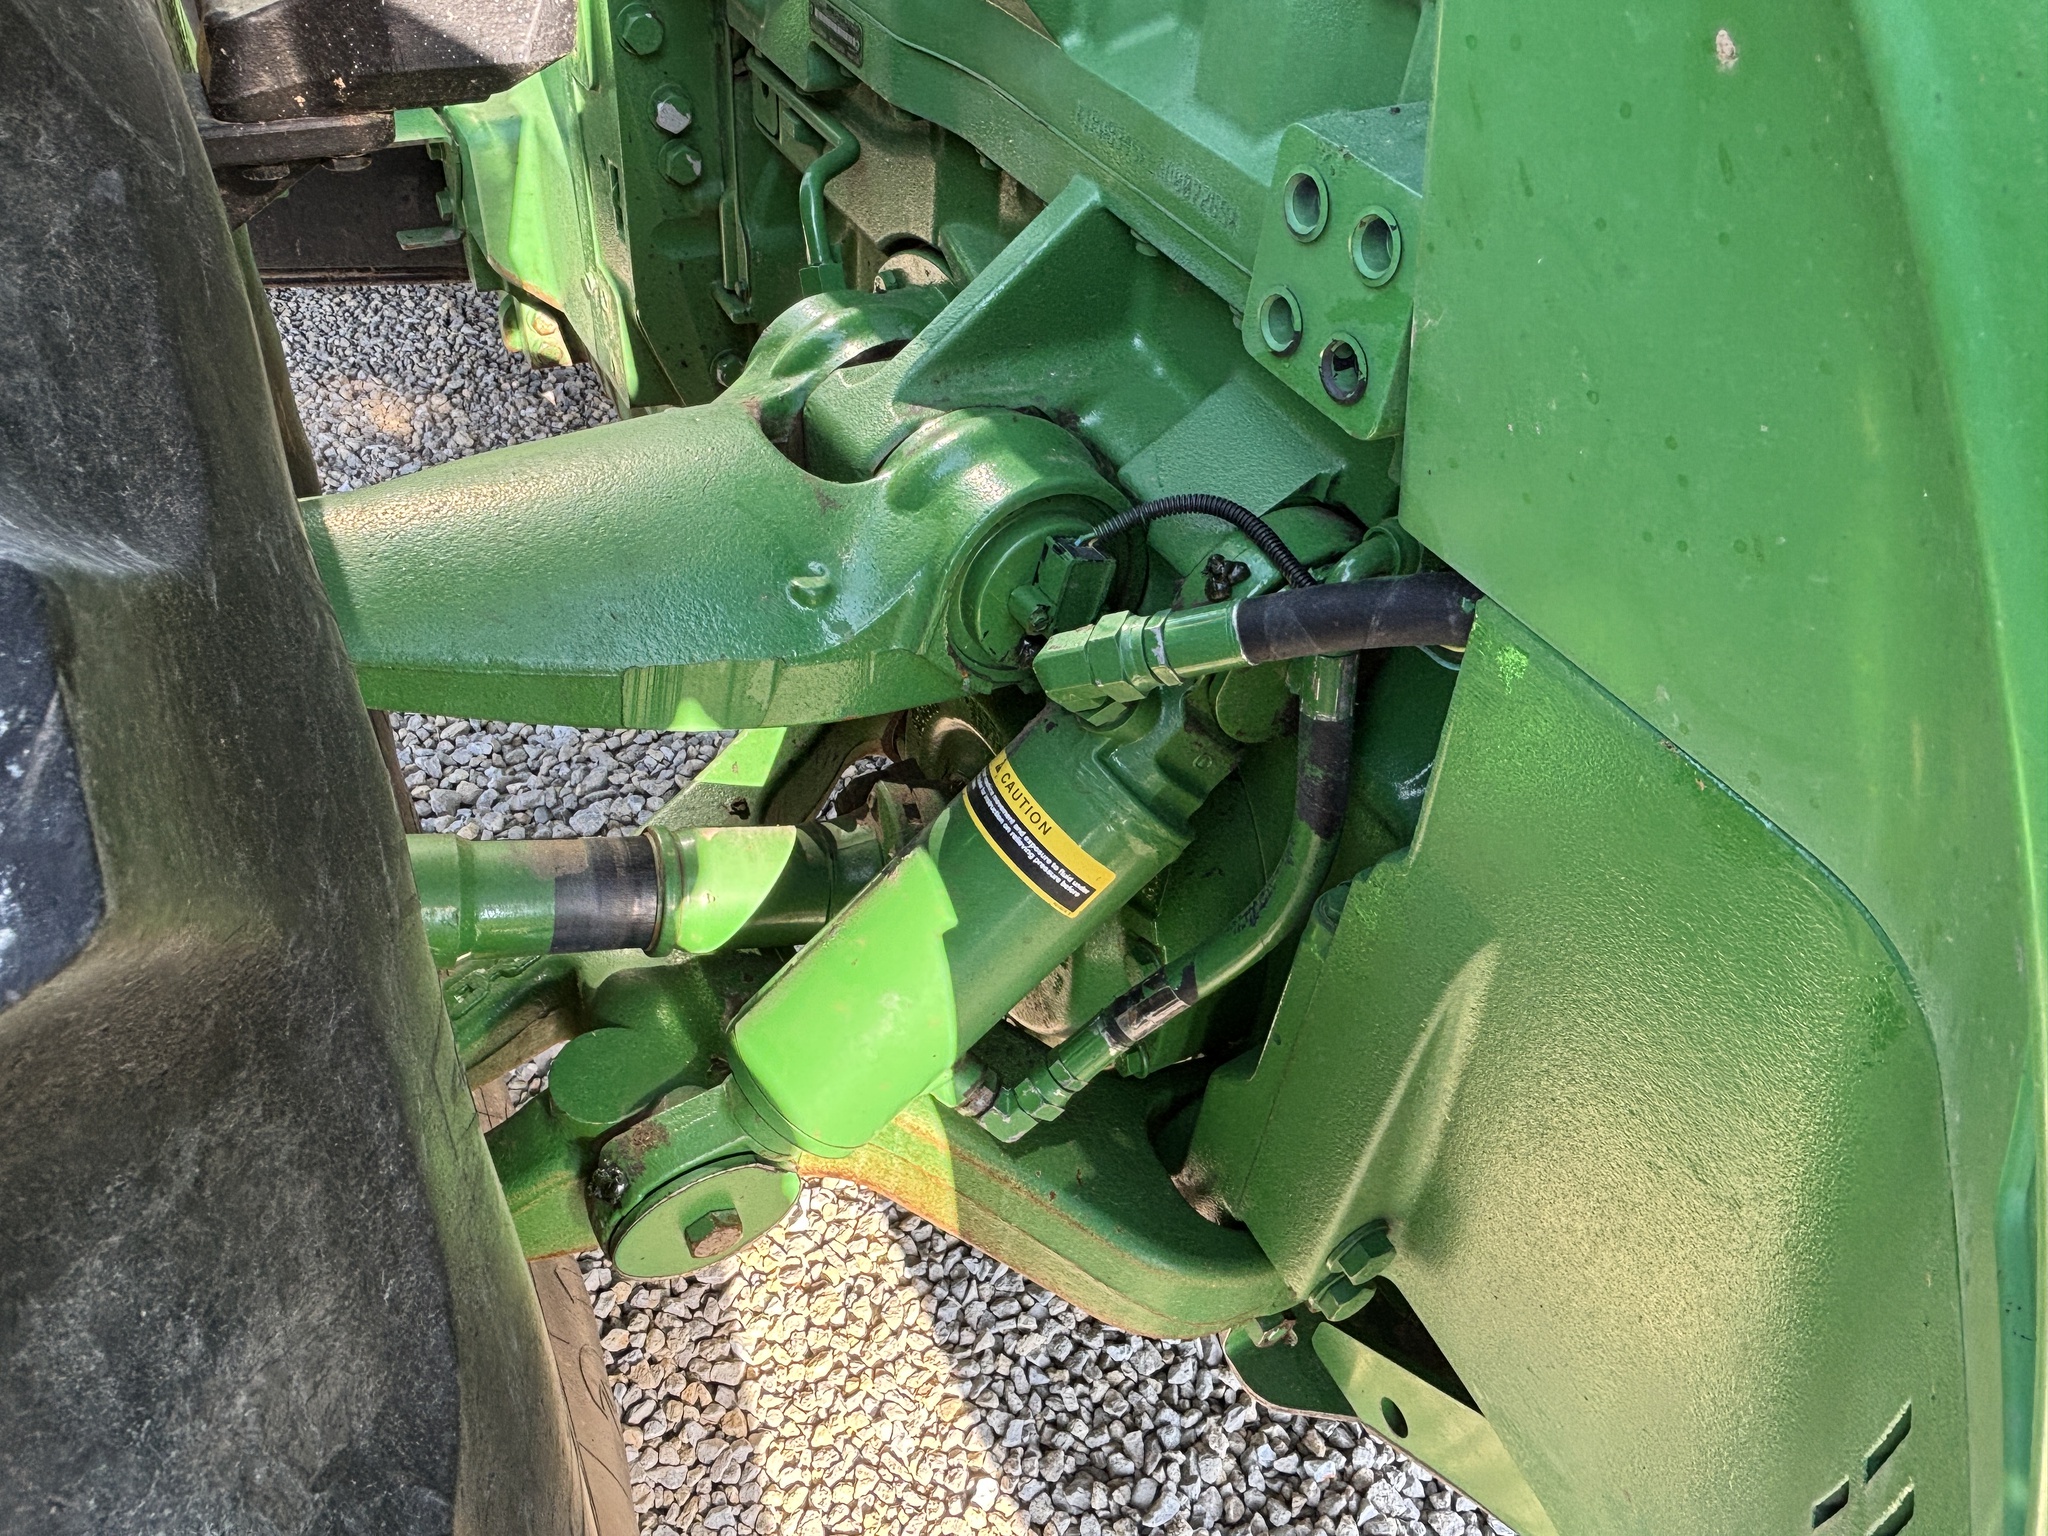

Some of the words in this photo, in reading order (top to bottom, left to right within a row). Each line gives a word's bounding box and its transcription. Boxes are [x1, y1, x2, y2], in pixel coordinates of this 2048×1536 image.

[1000, 772, 1052, 836] CAUTION
[1001, 822, 1011, 833] on
[1009, 830, 1035, 860] relieving
[1032, 856, 1062, 883] pressure
[1059, 879, 1081, 898] before
[1012, 822, 1026, 837] and
[1021, 834, 1052, 865] exposure
[1050, 861, 1060, 871] to
[1057, 867, 1075, 882] fluid
[1071, 879, 1090, 895] under
